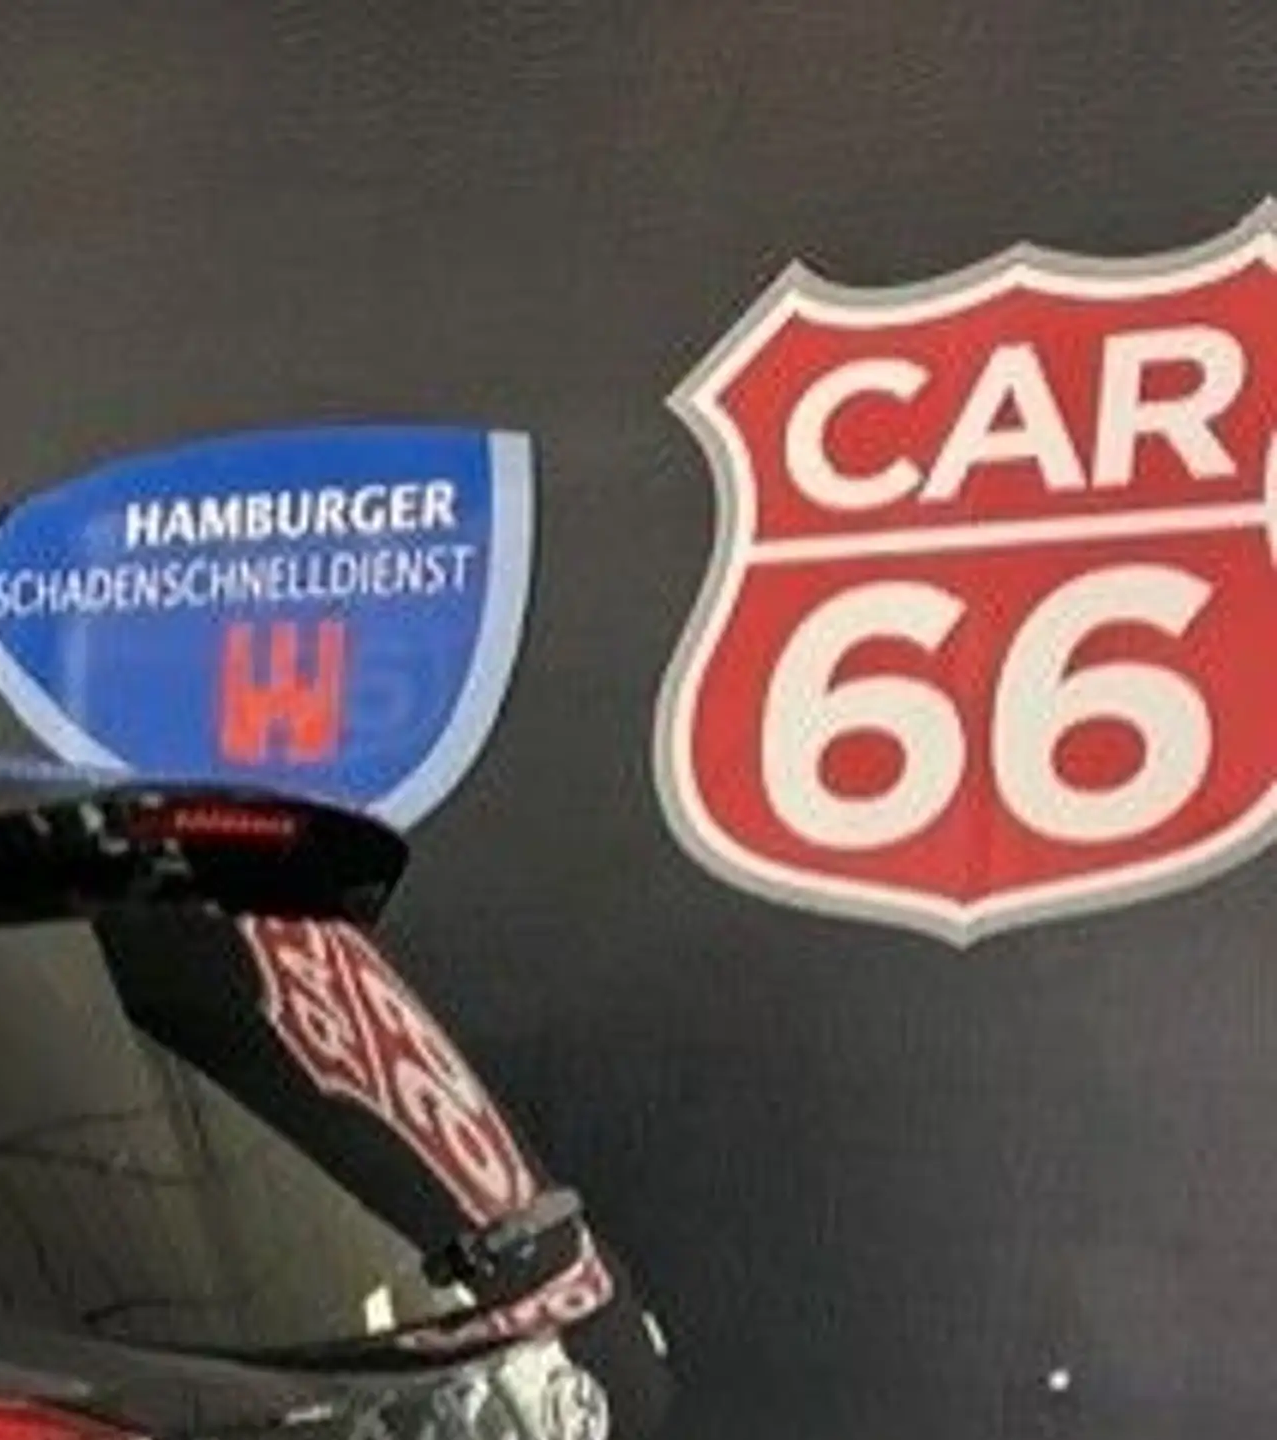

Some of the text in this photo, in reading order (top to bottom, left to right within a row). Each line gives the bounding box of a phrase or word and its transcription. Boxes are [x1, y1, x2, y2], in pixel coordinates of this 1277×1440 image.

[784, 324, 1247, 511] CAR
[126, 479, 457, 549] HAMBURGER
[760, 564, 1215, 851] 66
